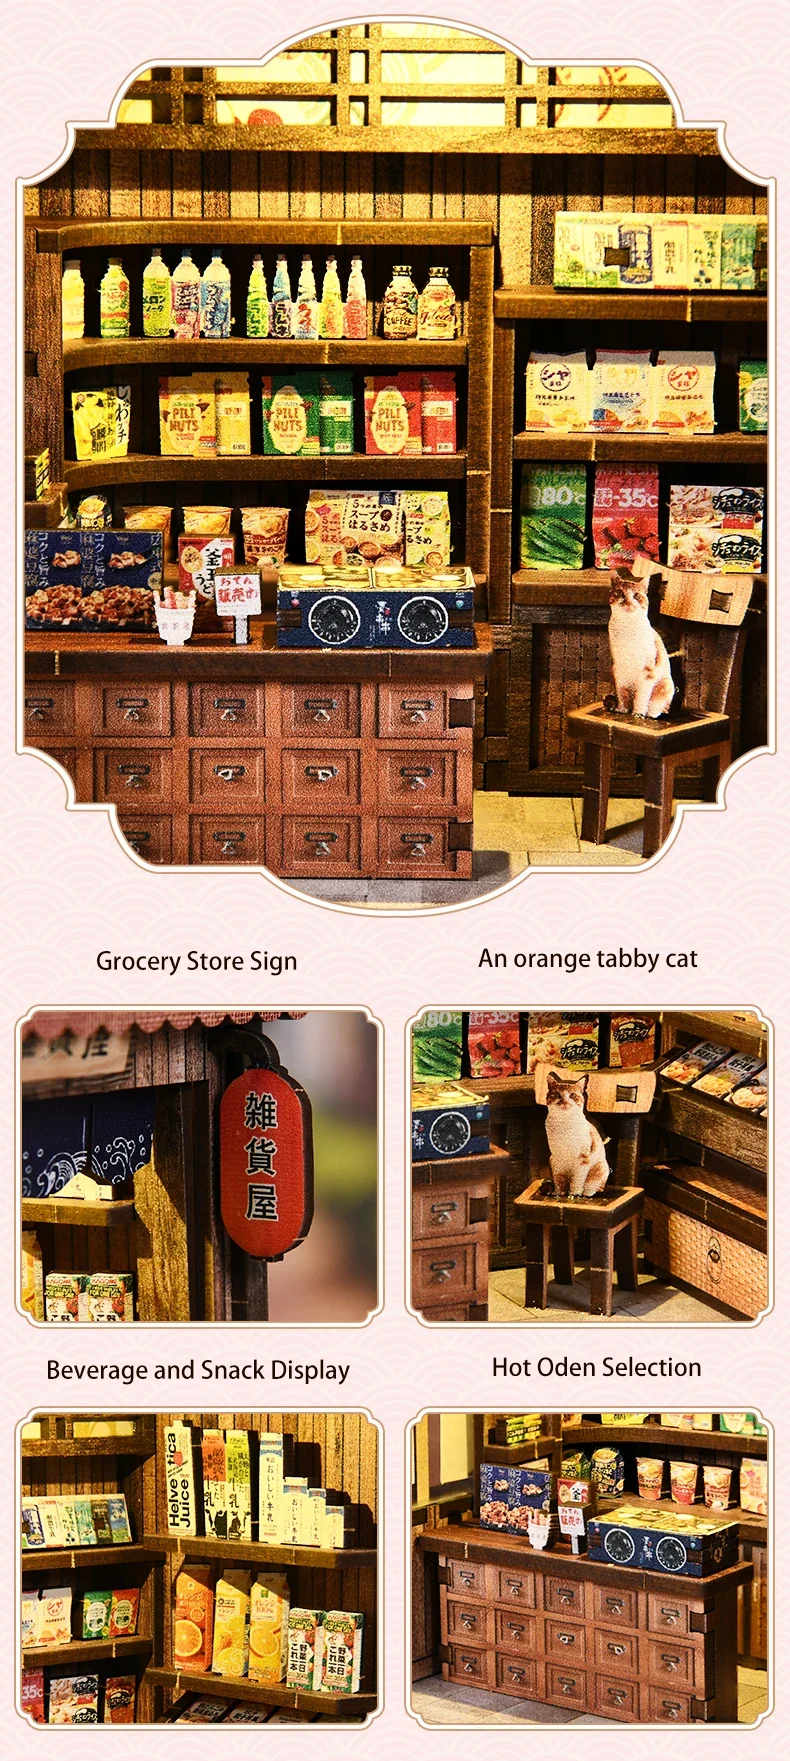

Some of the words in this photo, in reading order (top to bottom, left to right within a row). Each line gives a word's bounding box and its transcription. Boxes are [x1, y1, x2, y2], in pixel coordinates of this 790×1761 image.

[172, 407, 194, 420] PILI
[275, 407, 299, 420] PILI
[378, 407, 401, 420] PILI
[169, 419, 200, 432] NUTS
[273, 419, 303, 432] NUTS
[375, 419, 405, 432] NUTS
[349, 510, 380, 521] スープ
[348, 519, 391, 532] はるさめ
[196, 574, 215, 598] うど
[220, 576, 253, 585] おでん
[245, 1092, 278, 1222] 雑貨屋
[179, 1479, 191, 1528] Juice
[290, 1643, 299, 1671] これ一本
[298, 1643, 308, 1673] 野菜一日
[328, 1645, 337, 1674] これ一本
[337, 1646, 347, 1675] 野菜一日
